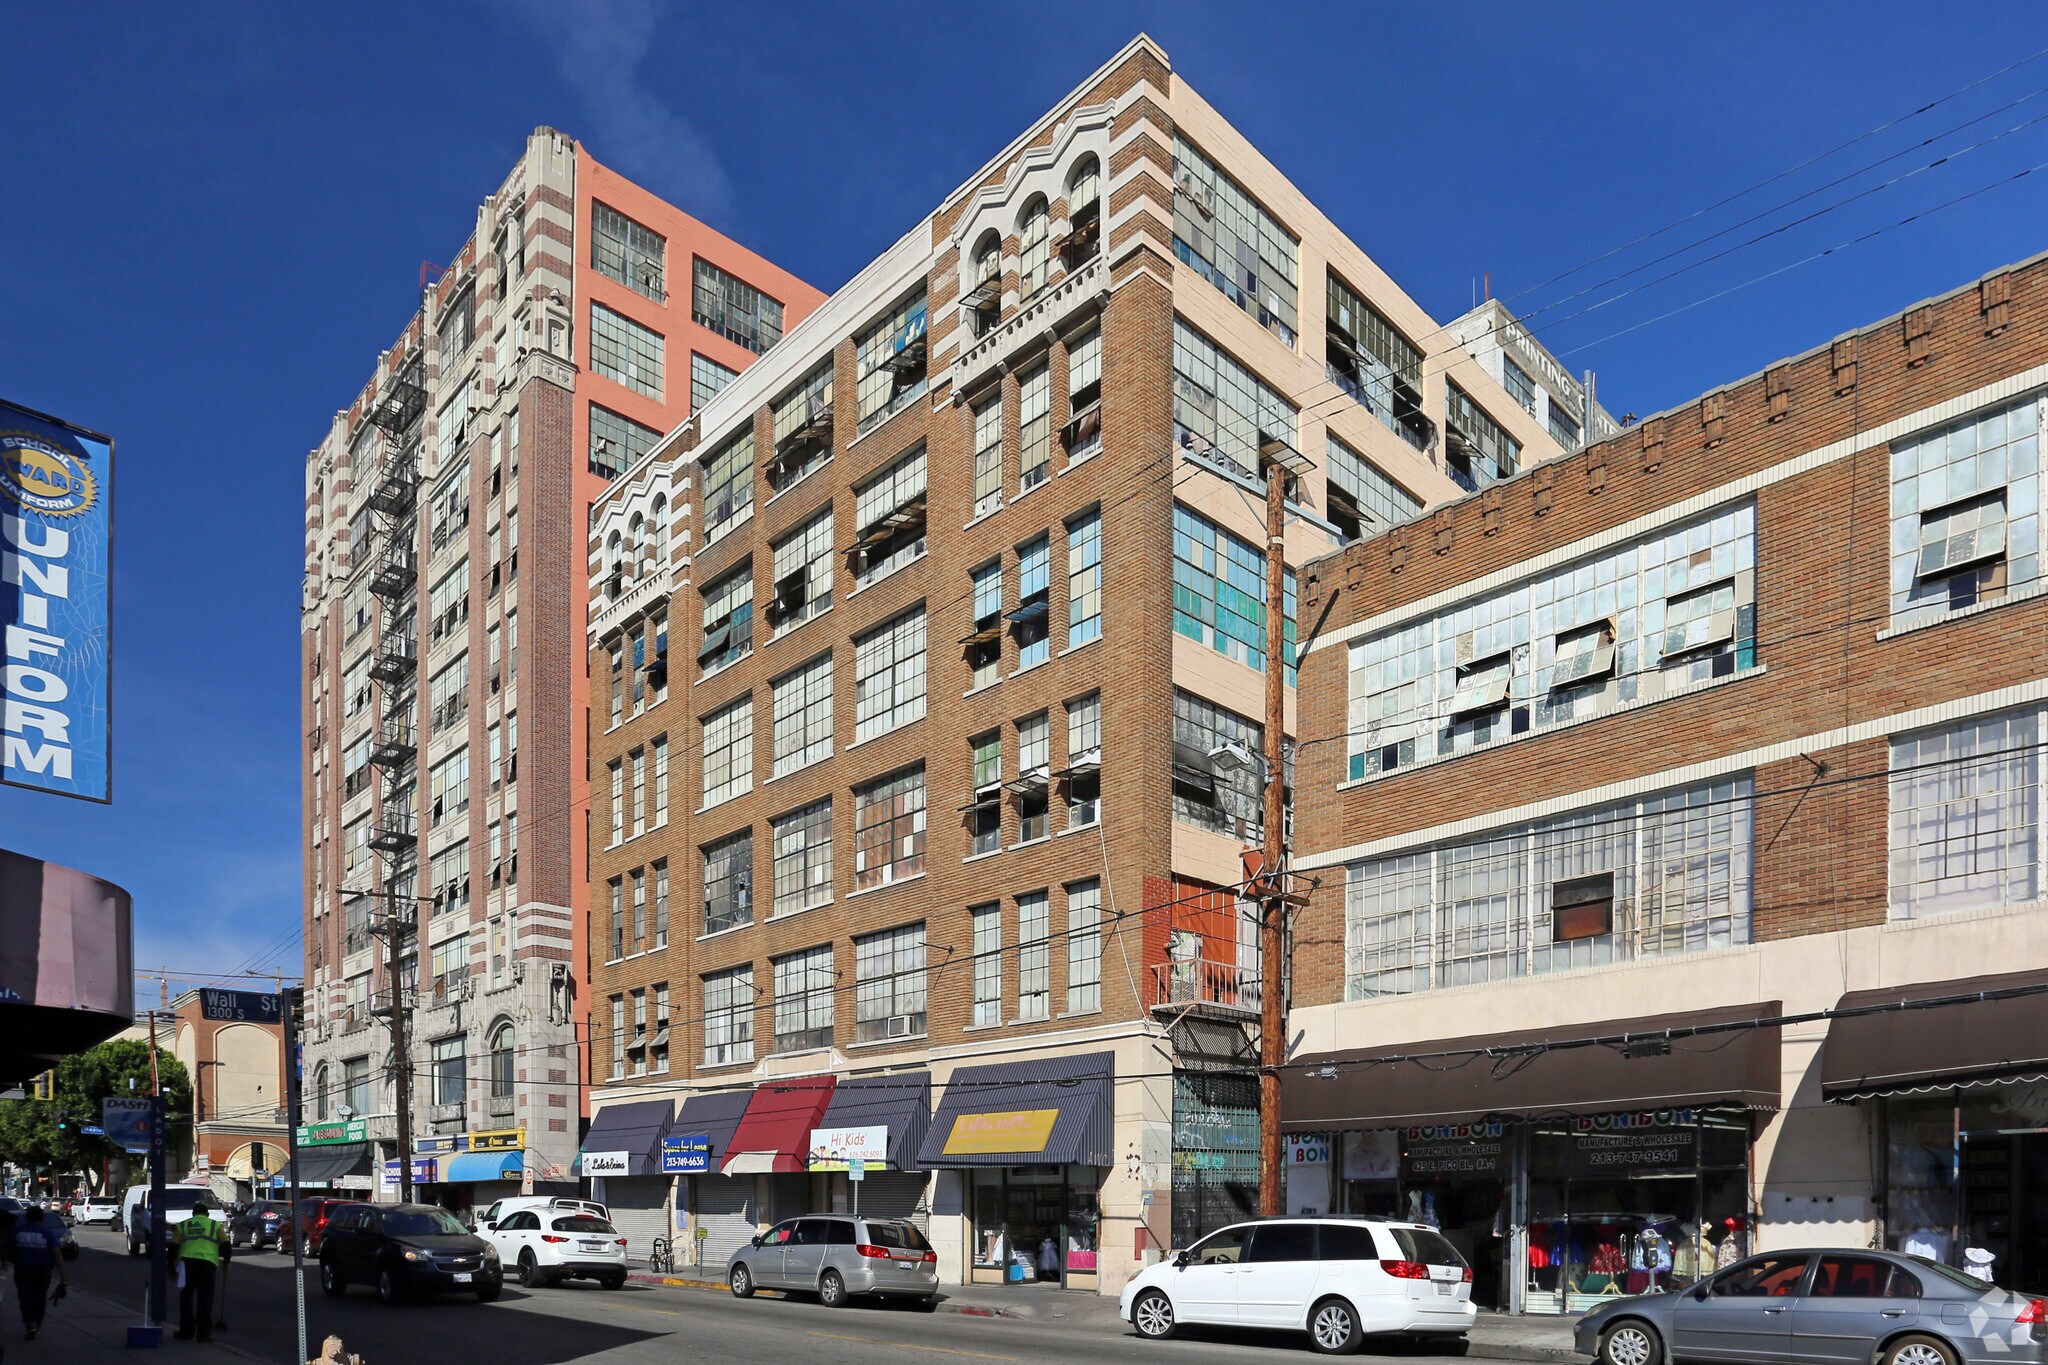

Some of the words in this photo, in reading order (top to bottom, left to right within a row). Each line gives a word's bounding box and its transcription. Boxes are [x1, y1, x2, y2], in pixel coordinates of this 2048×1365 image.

[1505, 320, 1570, 396] PRINTING
[2, 437, 70, 468] SCHOOL
[7, 457, 86, 494] WARD
[0, 474, 74, 508] UNIFORM
[0, 513, 72, 780] UNIFORM
[206, 990, 237, 1008] Wall
[261, 995, 278, 1011] St
[207, 1006, 232, 1018] 1300
[237, 1008, 244, 1019] S
[106, 1099, 149, 1110] DASH
[154, 1106, 163, 1156] LADOT
[348, 1131, 363, 1141] FOOD
[663, 1141, 680, 1156] Space
[681, 1139, 689, 1152] for
[690, 1139, 707, 1152] Lease
[831, 1133, 842, 1146] Hi
[845, 1132, 865, 1147] Kids
[1577, 1136, 1634, 1149] MANUFACTURE
[1642, 1133, 1692, 1146] WHOLESALE
[849, 1149, 883, 1159] 626.242.6093
[1295, 1147, 1330, 1163] BON
[1408, 1145, 1453, 1157] MANUFACTURE
[1461, 1143, 1501, 1156] WHOLESALE
[1590, 1149, 1678, 1165] 213-747-9541
[666, 1156, 705, 1167] 213-749-6636
[1412, 1160, 1427, 1171] 425
[1428, 1160, 1436, 1171] E.
[1438, 1159, 1458, 1171] PICO
[1459, 1159, 1474, 1170] BL.
[1476, 1158, 1496, 1170] #A-1
